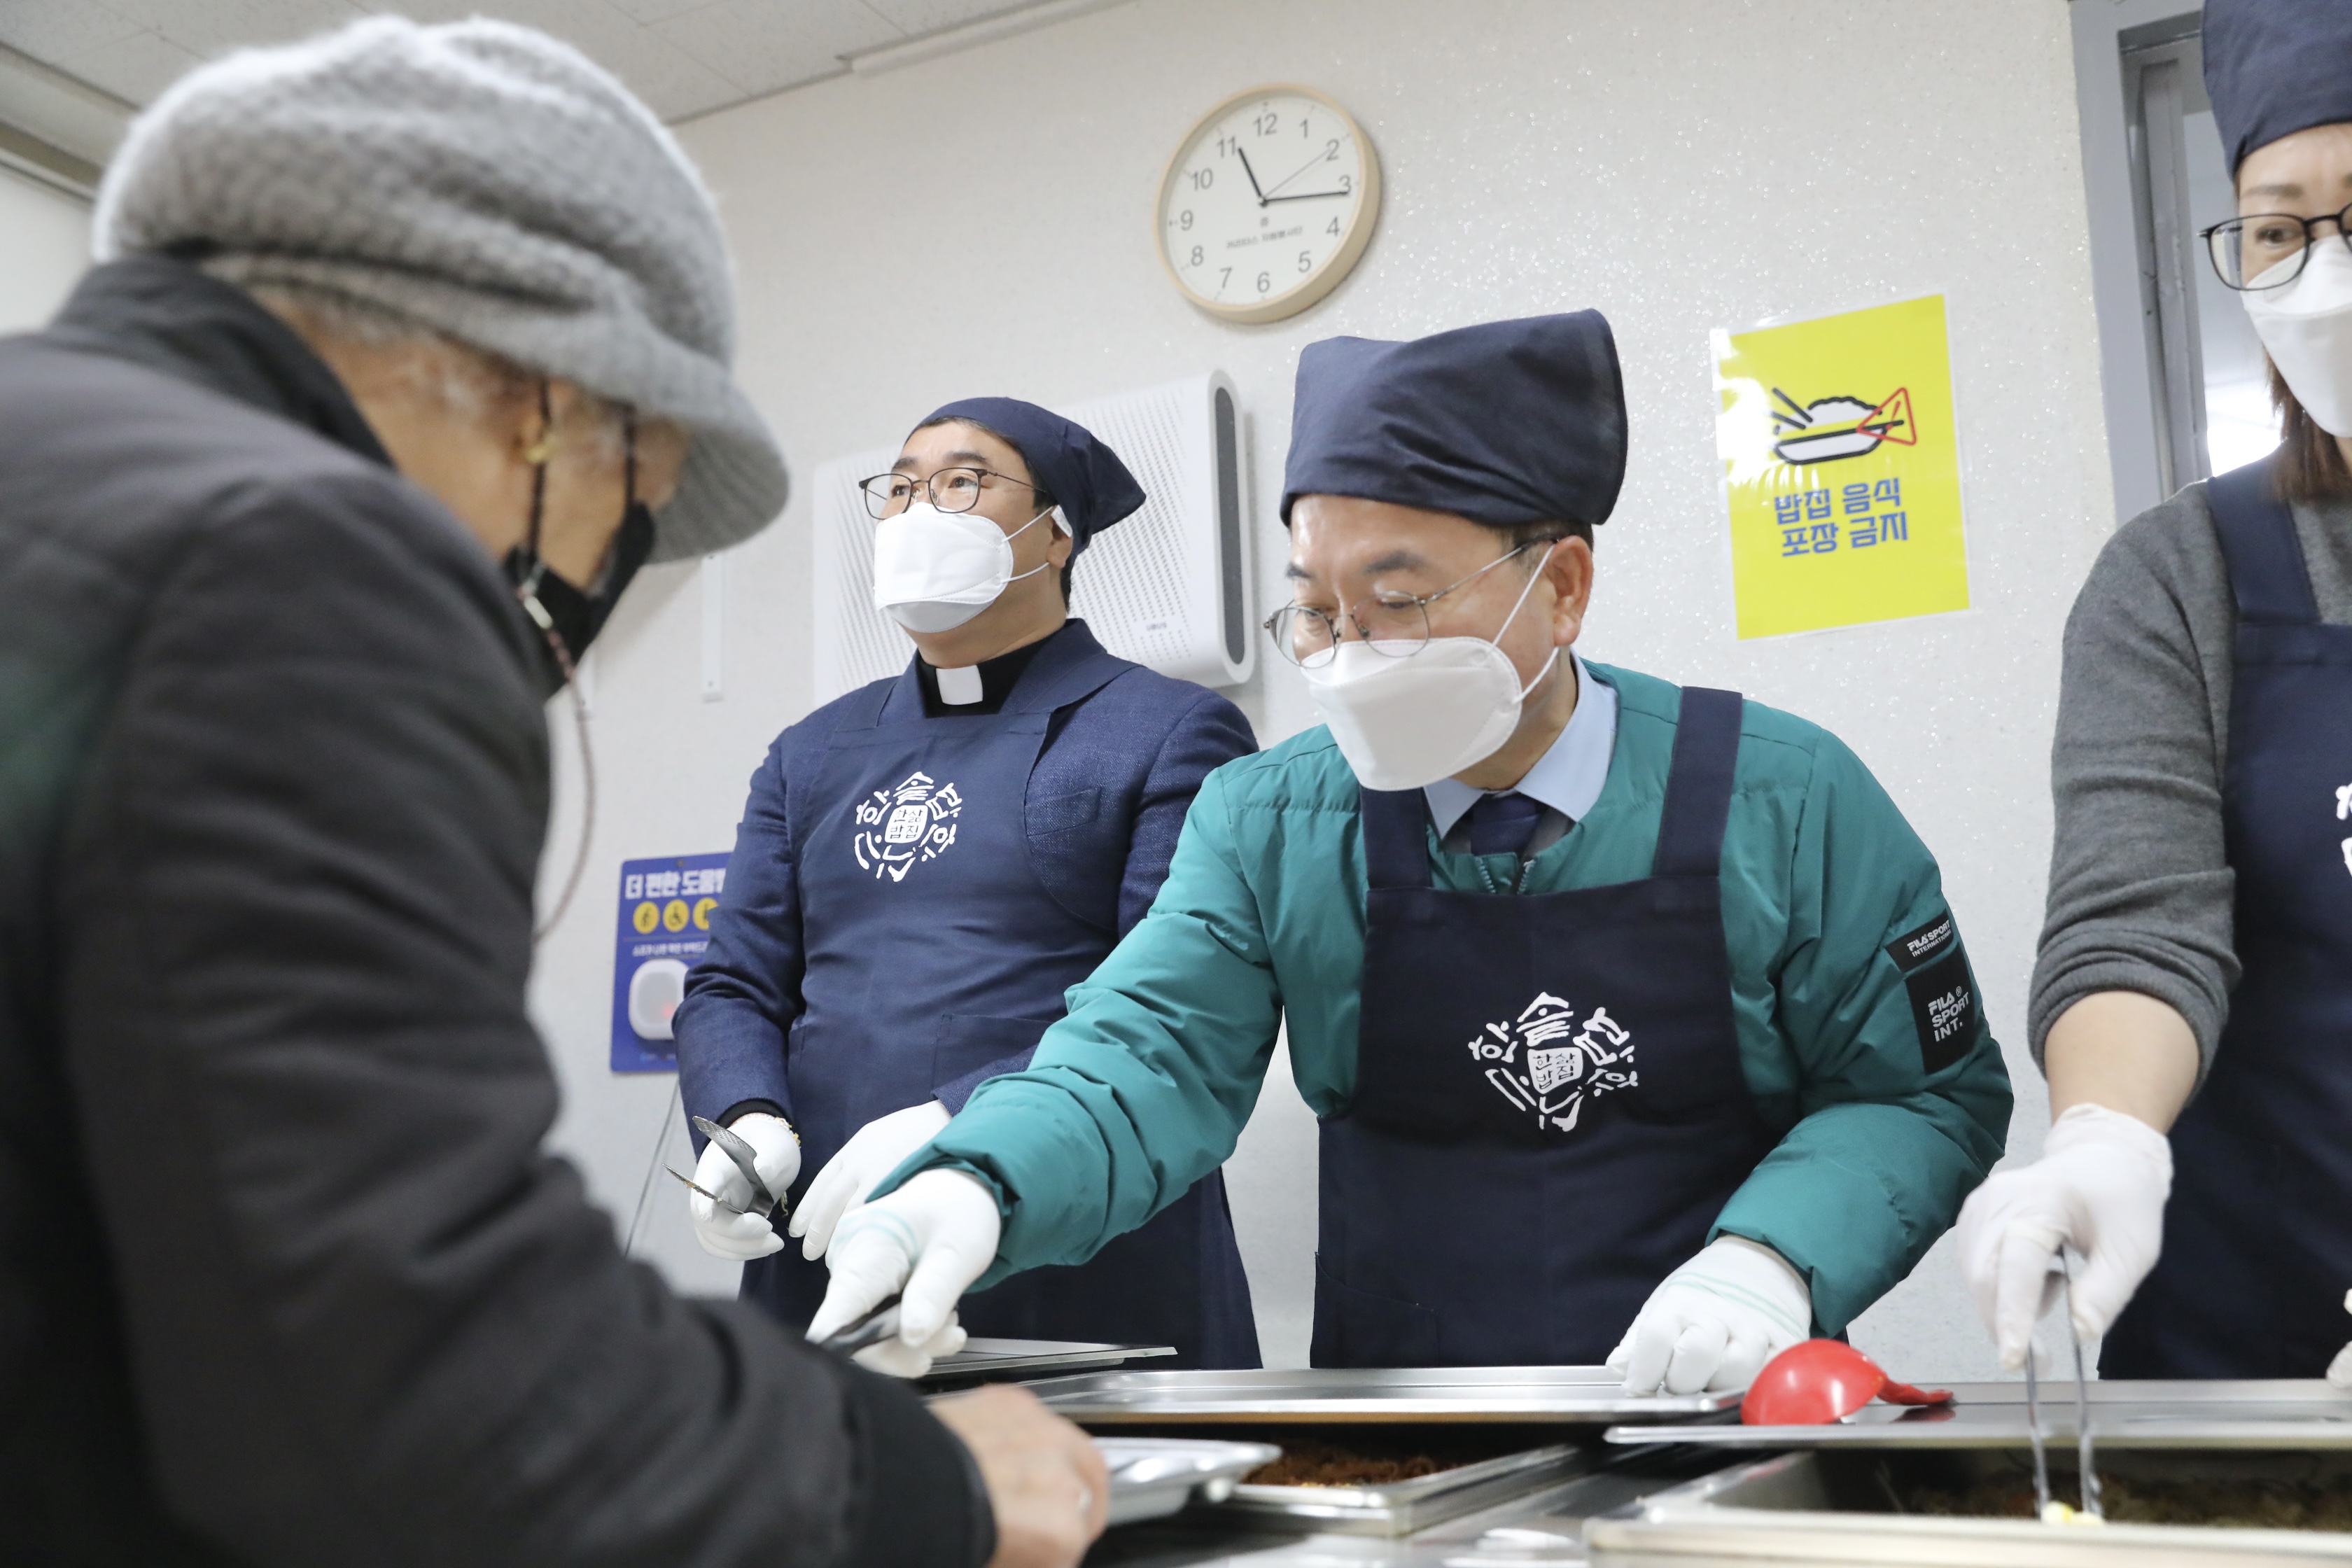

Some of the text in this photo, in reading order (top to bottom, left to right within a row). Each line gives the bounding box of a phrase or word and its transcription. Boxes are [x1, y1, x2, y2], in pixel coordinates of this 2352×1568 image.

[1253, 113, 1278, 136] 12
[1299, 119, 1308, 139] 1
[1217, 135, 1237, 158] 11
[1326, 139, 1340, 162] 2
[1191, 168, 1213, 191] 10
[1338, 175, 1352, 193] 3
[1180, 209, 1194, 231] 9
[1326, 216, 1340, 237] 4
[1191, 246, 1204, 267] 8
[1298, 251, 1312, 273] 5
[1219, 266, 1233, 289] 7
[1256, 272, 1270, 293] 6
[1774, 477, 1902, 525] 밥집 음식
[1782, 511, 1908, 557] 포장 금지
[1907, 920, 1949, 952] FILA SPORT
[1928, 991, 1955, 1016] FILA
[1931, 992, 1969, 1028] SPORT
[1934, 1017, 1963, 1042] INT.
